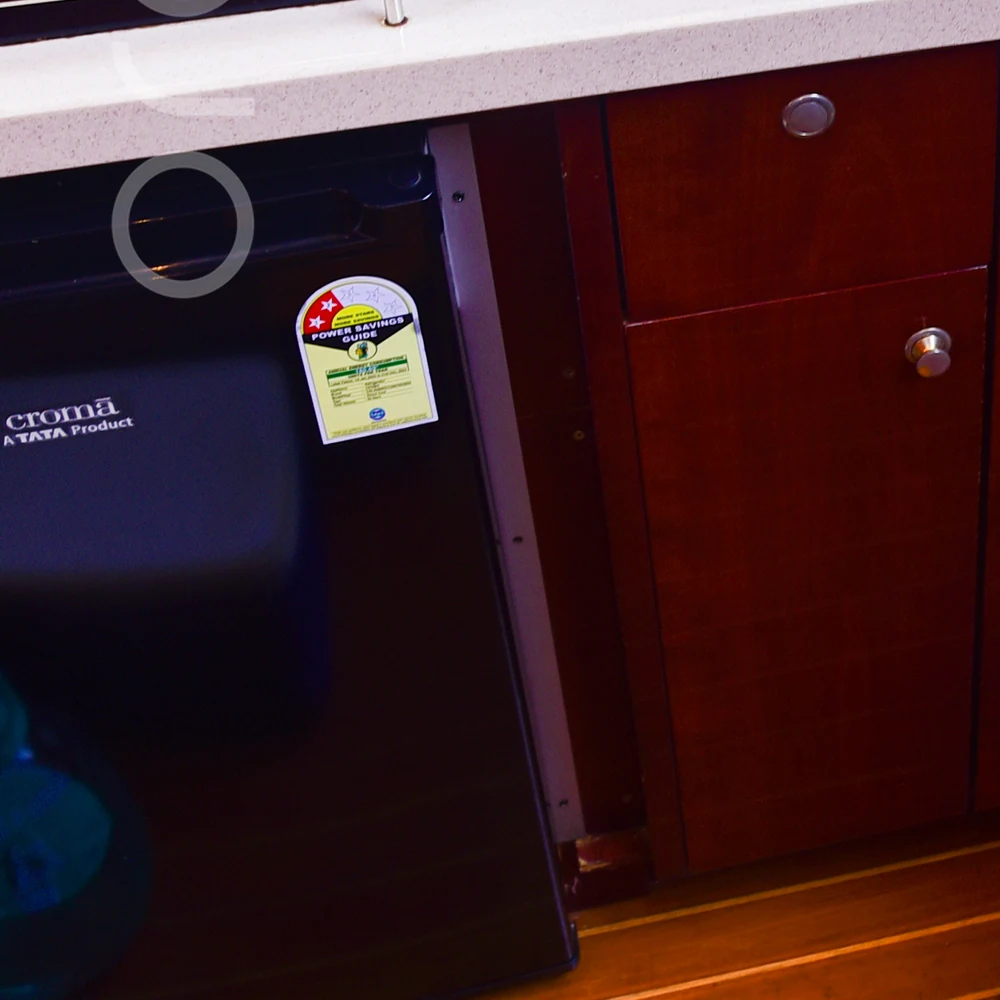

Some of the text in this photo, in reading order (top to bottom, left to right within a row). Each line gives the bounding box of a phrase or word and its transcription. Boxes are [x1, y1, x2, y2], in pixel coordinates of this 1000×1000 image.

[311, 316, 405, 341] POWER SAVINGS
[342, 330, 378, 344] GUIDE
[3, 416, 135, 447] A TATA Product
